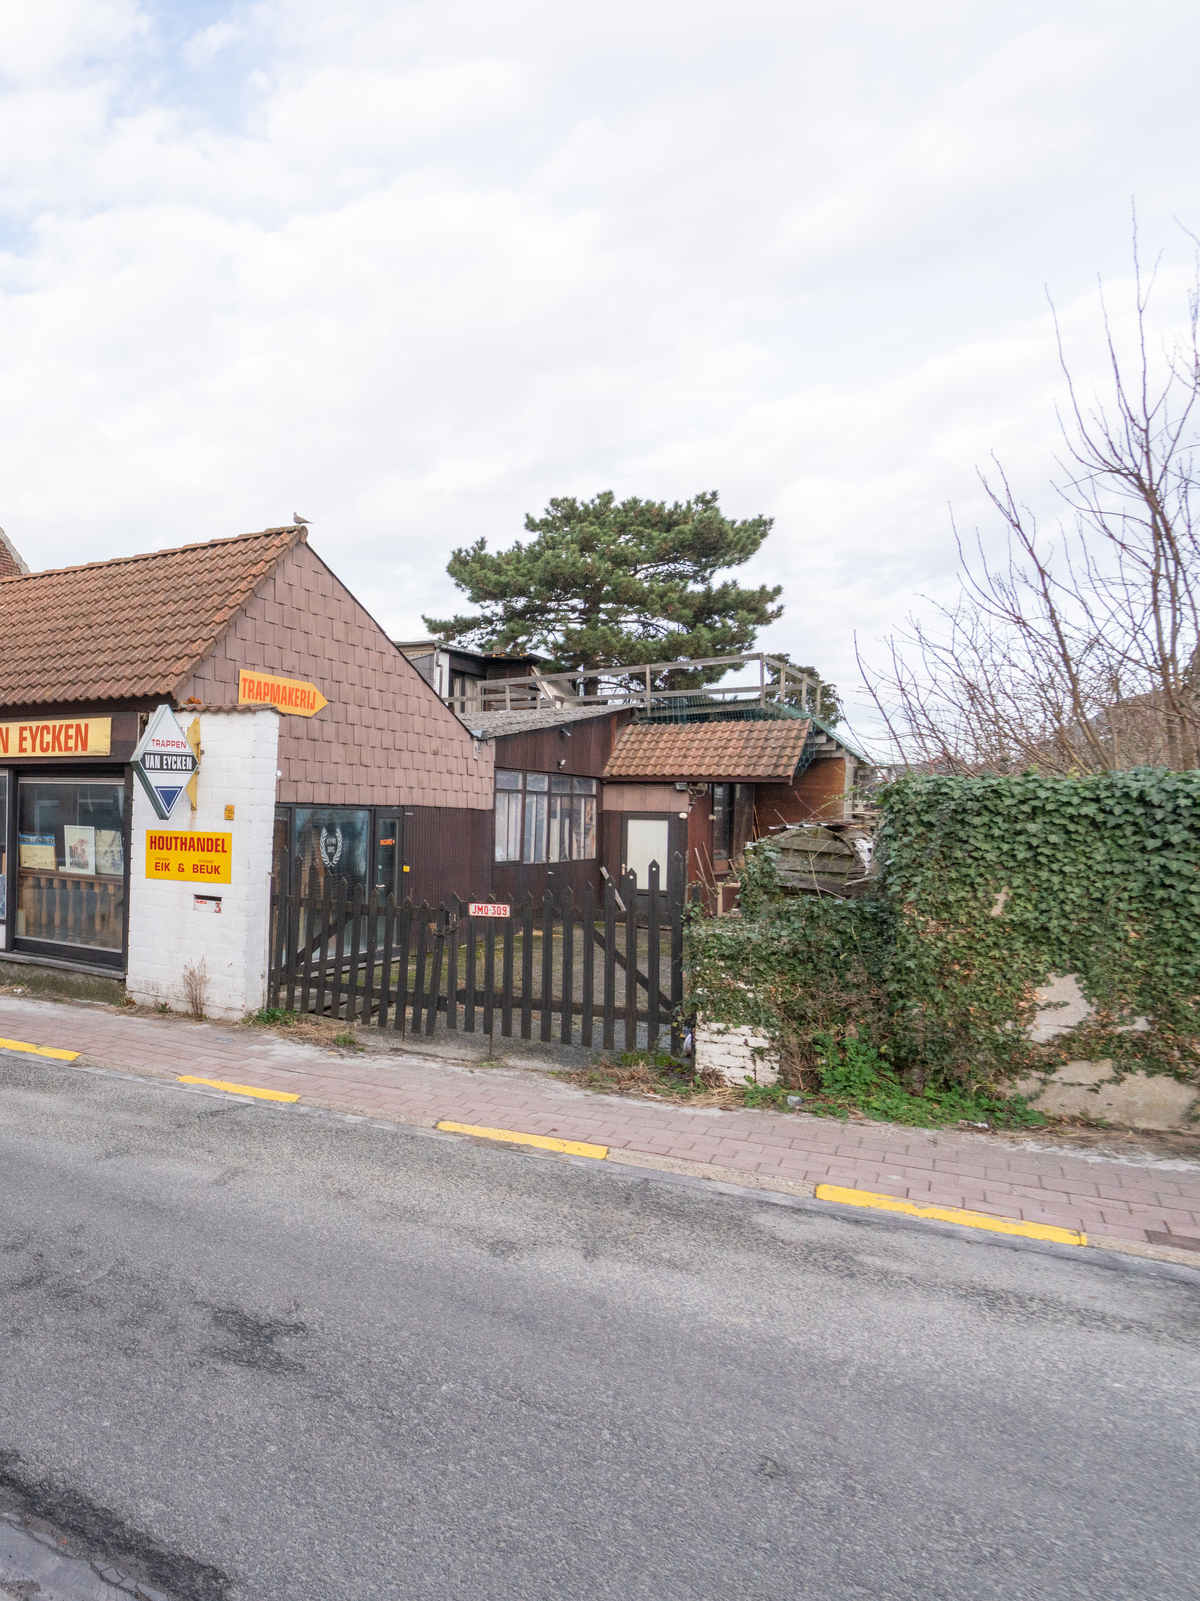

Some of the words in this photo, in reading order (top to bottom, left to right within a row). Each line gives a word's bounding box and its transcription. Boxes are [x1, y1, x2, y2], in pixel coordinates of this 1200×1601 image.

[242, 677, 316, 711] TRAPMAKERIJ
[18, 723, 89, 753] EYCKEN
[151, 739, 187, 749] TRAPPEN
[145, 754, 161, 769] VAN
[163, 754, 193, 770] EYCKEN
[149, 835, 228, 854] HOUTHANDEL
[154, 862, 170, 872] EIK
[178, 863, 185, 873] &
[192, 864, 221, 875] BEUK
[214, 902, 222, 913] 3
